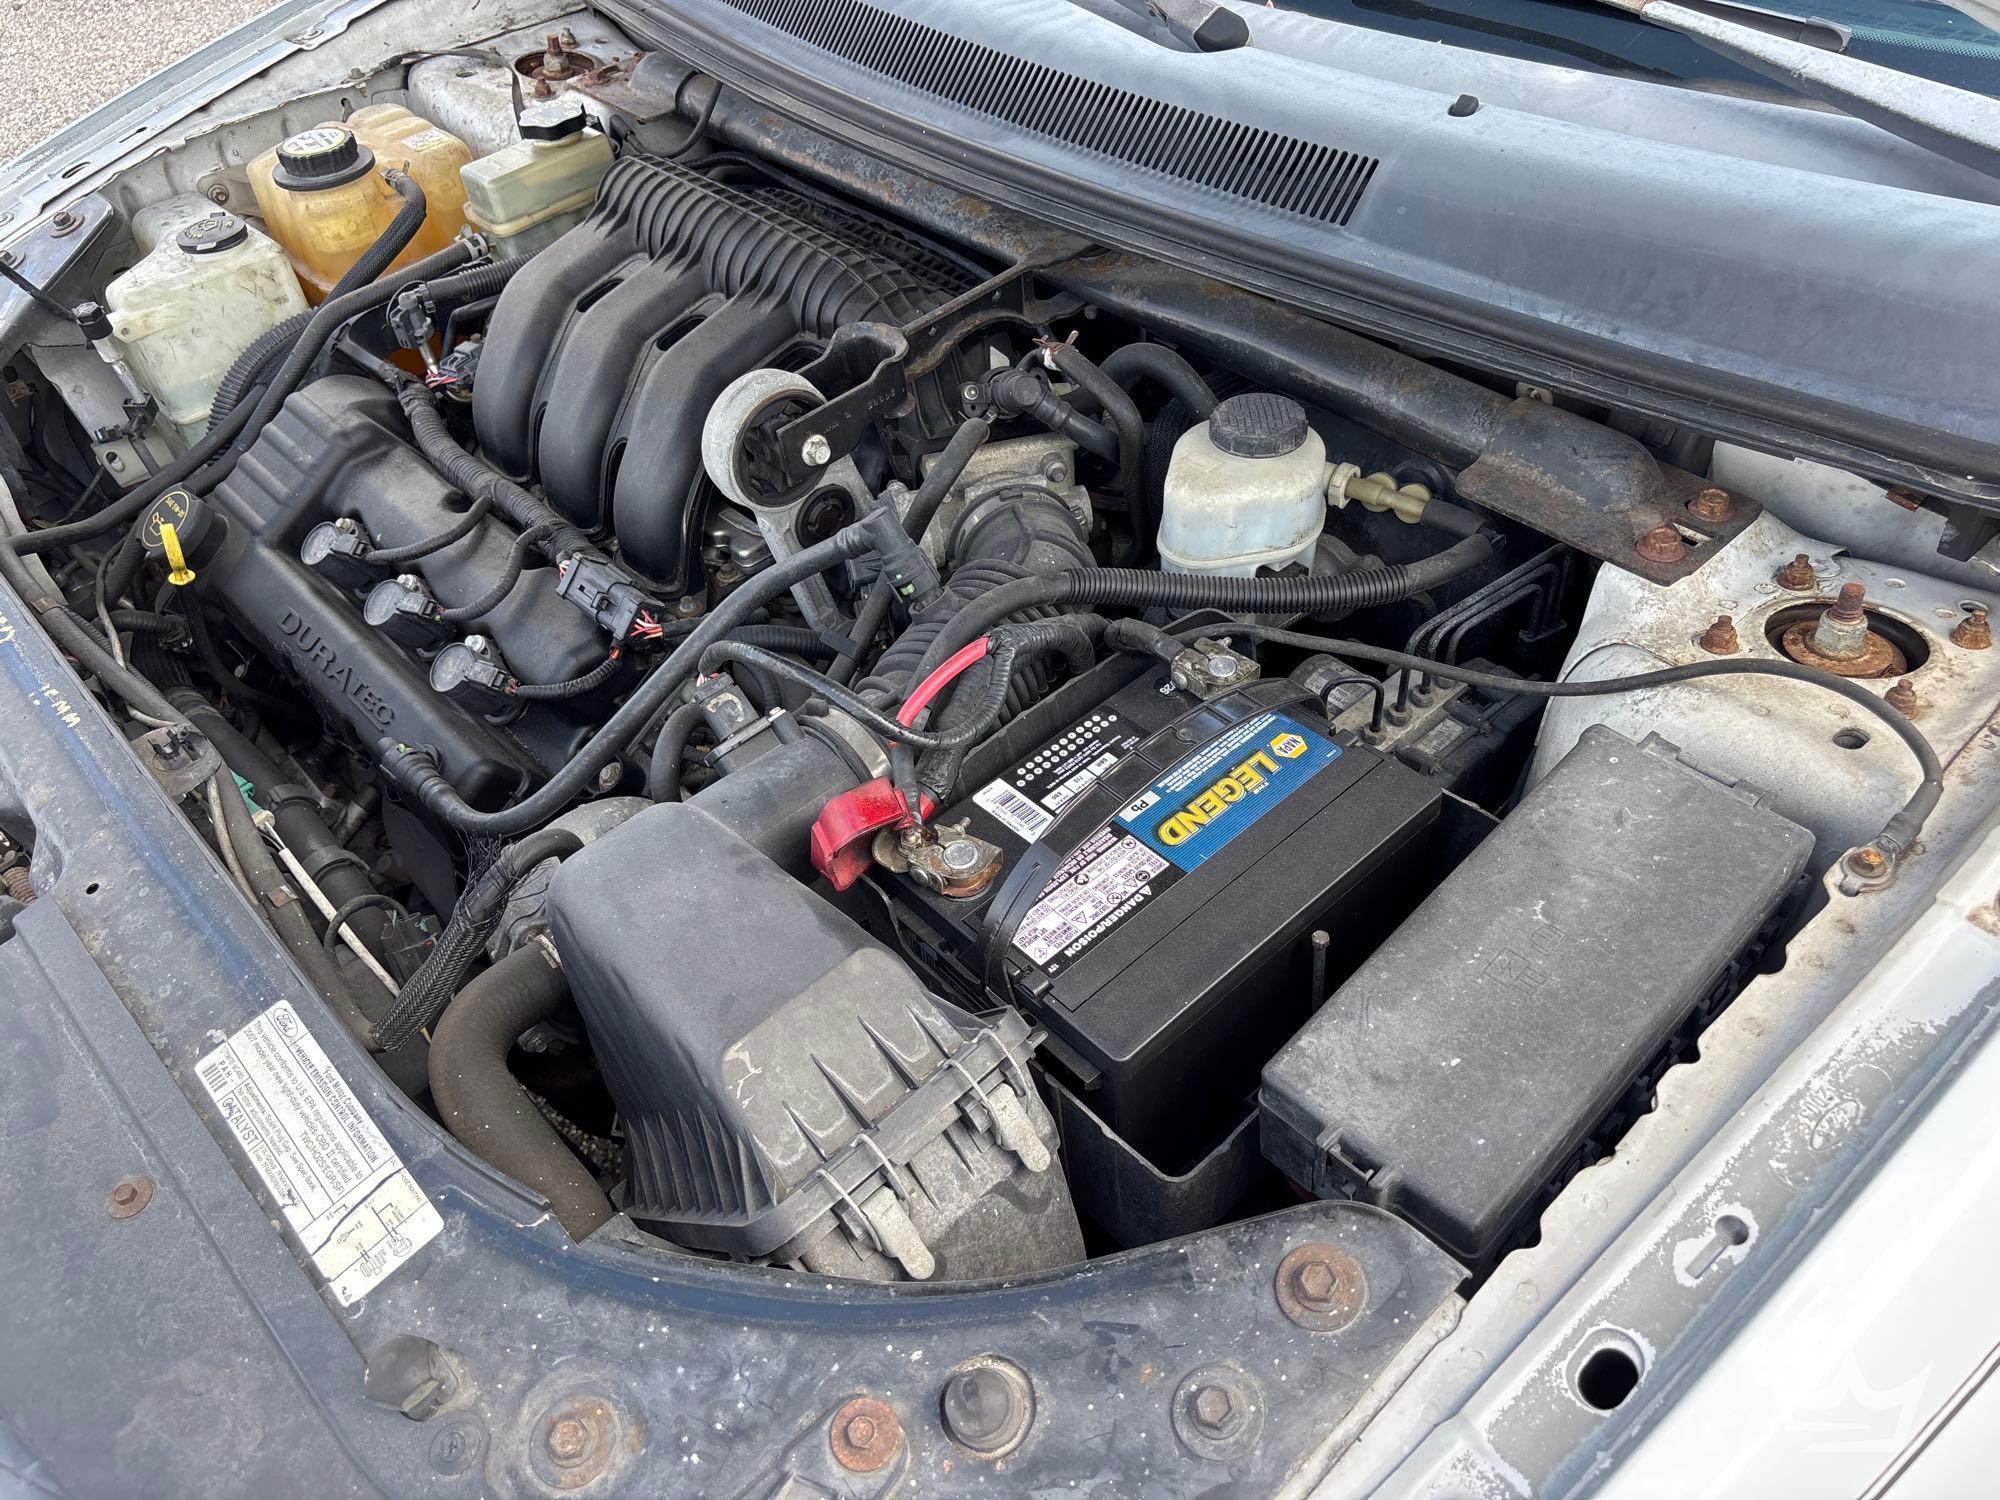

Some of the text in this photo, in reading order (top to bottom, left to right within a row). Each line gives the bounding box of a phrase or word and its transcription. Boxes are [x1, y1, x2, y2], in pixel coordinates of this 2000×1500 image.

[278, 606, 396, 728] DURATEC
[1275, 736, 1301, 755] NAPA
[1129, 799, 1149, 813] Pb
[1150, 749, 1283, 849] LEGEND
[1063, 893, 1144, 957] DANGER/POISON
[1047, 963, 1059, 972] 12V
[221, 1096, 258, 1146] CATALYST
[243, 1027, 256, 1043] 2007
[253, 1041, 268, 1059] model
[262, 1058, 276, 1073] year
[272, 1071, 284, 1084] new
[279, 1083, 302, 1112] light-duty
[315, 1133, 330, 1151] OBD
[252, 1020, 364, 1180] This vehicle conforms to U.S. EPA regulations applicable to
[294, 1046, 378, 1163] VEHICLE EMISSION CONTROL INFORMATION
[322, 1068, 364, 1125] Ford Motor Company
[298, 1130, 345, 1196] TWC/HO2S/EGR/SFI
